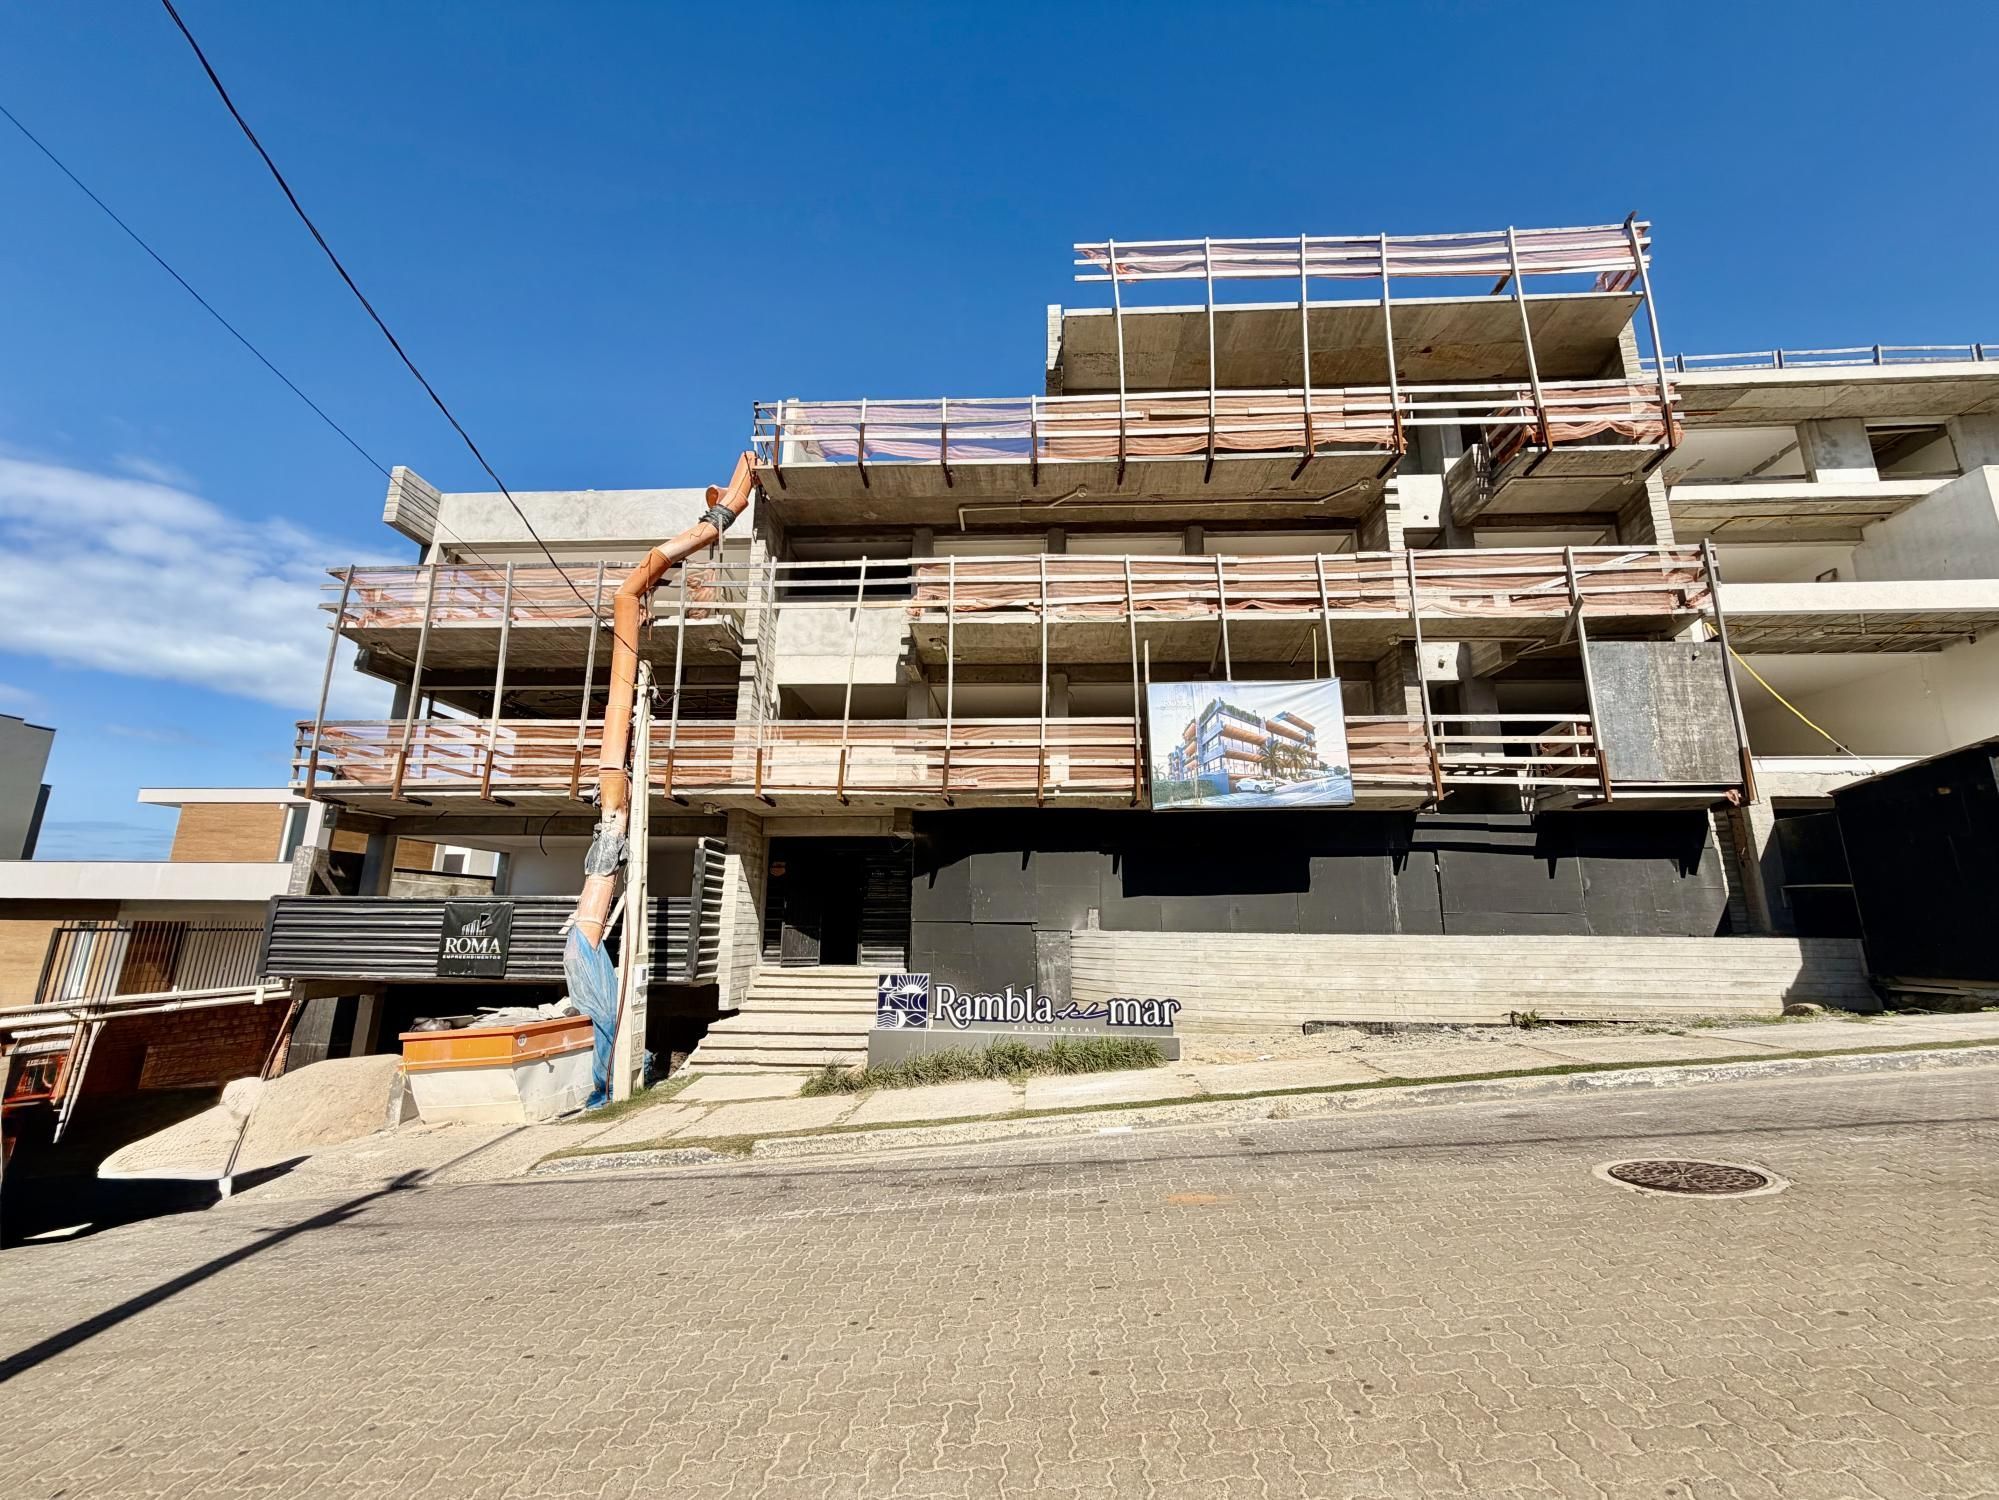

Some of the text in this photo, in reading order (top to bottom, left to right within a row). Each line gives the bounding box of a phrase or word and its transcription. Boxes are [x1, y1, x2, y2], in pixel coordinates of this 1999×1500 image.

[443, 937, 502, 954] ROMA
[933, 983, 1182, 1030] Rambla del mar
[1013, 1025, 1098, 1034] RESIDENCIAL
